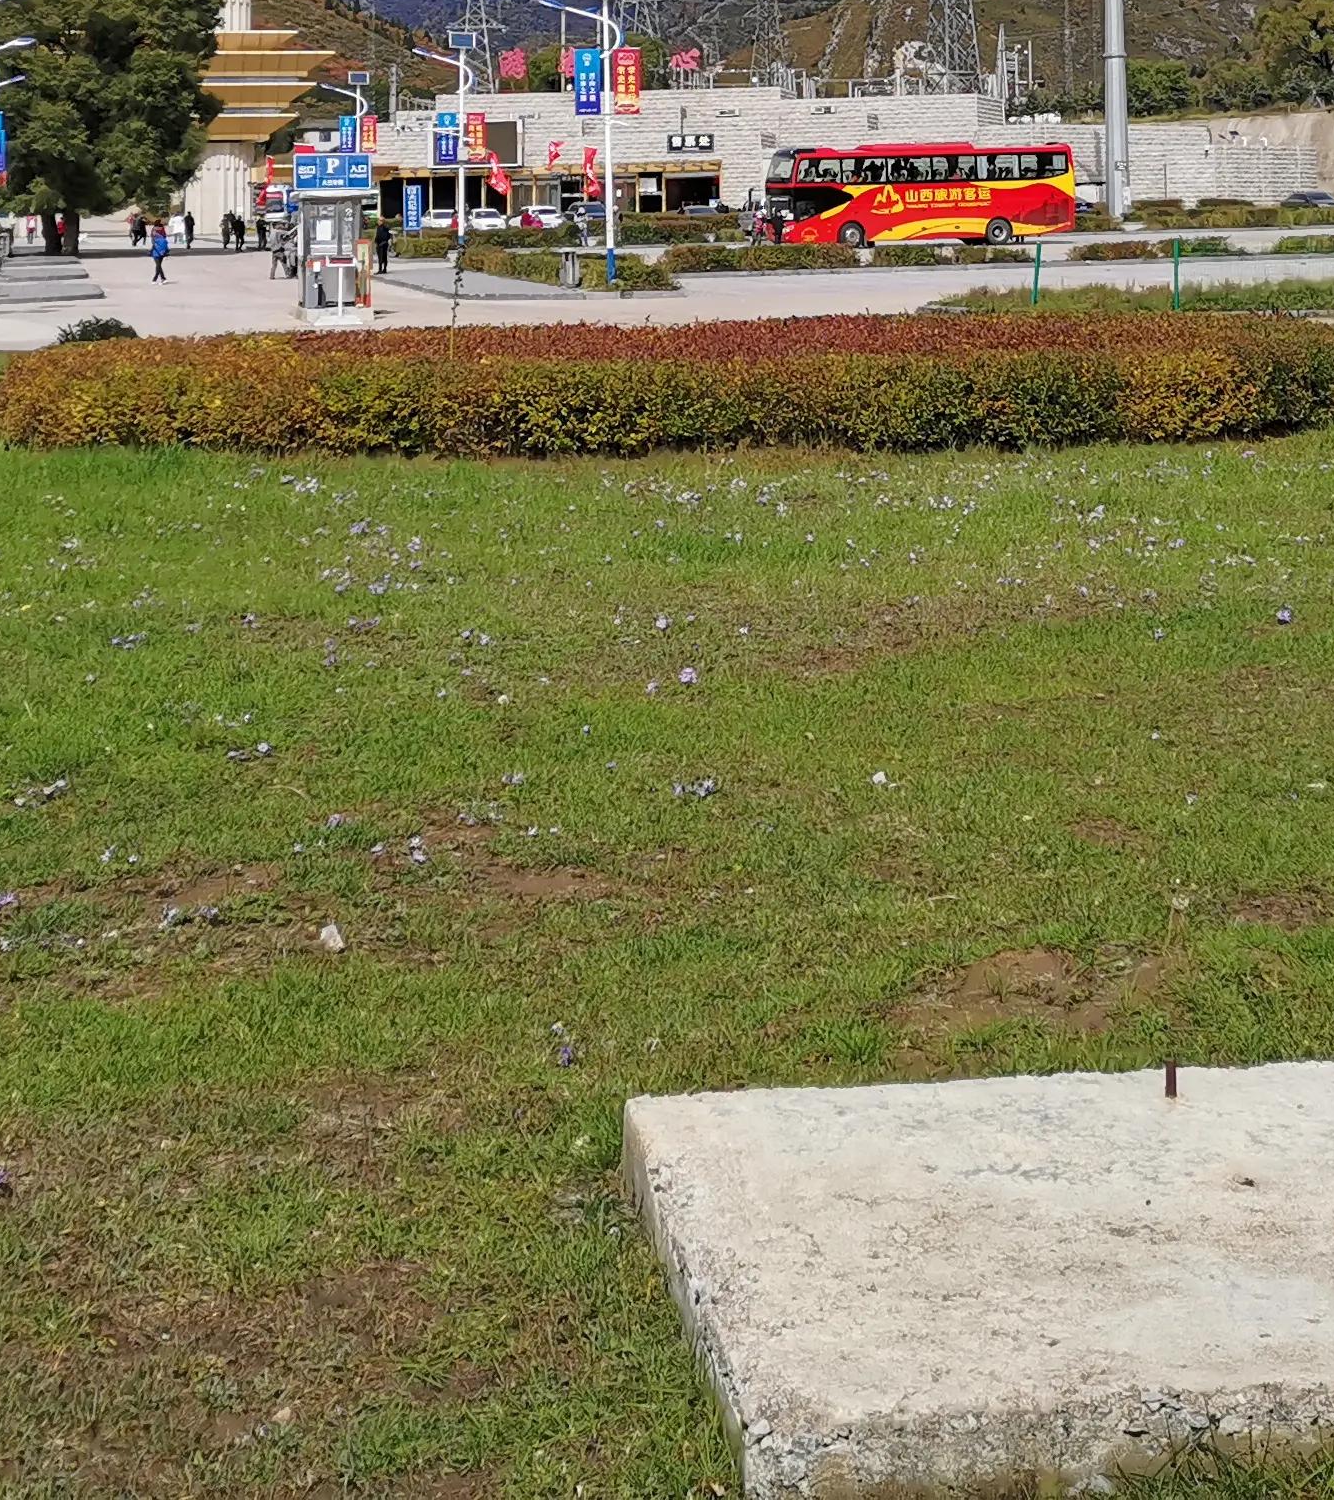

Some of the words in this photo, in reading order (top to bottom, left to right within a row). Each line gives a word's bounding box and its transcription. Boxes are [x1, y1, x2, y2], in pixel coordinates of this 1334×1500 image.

[326, 158, 340, 174] P
[905, 187, 992, 202] 山西旅游客运
